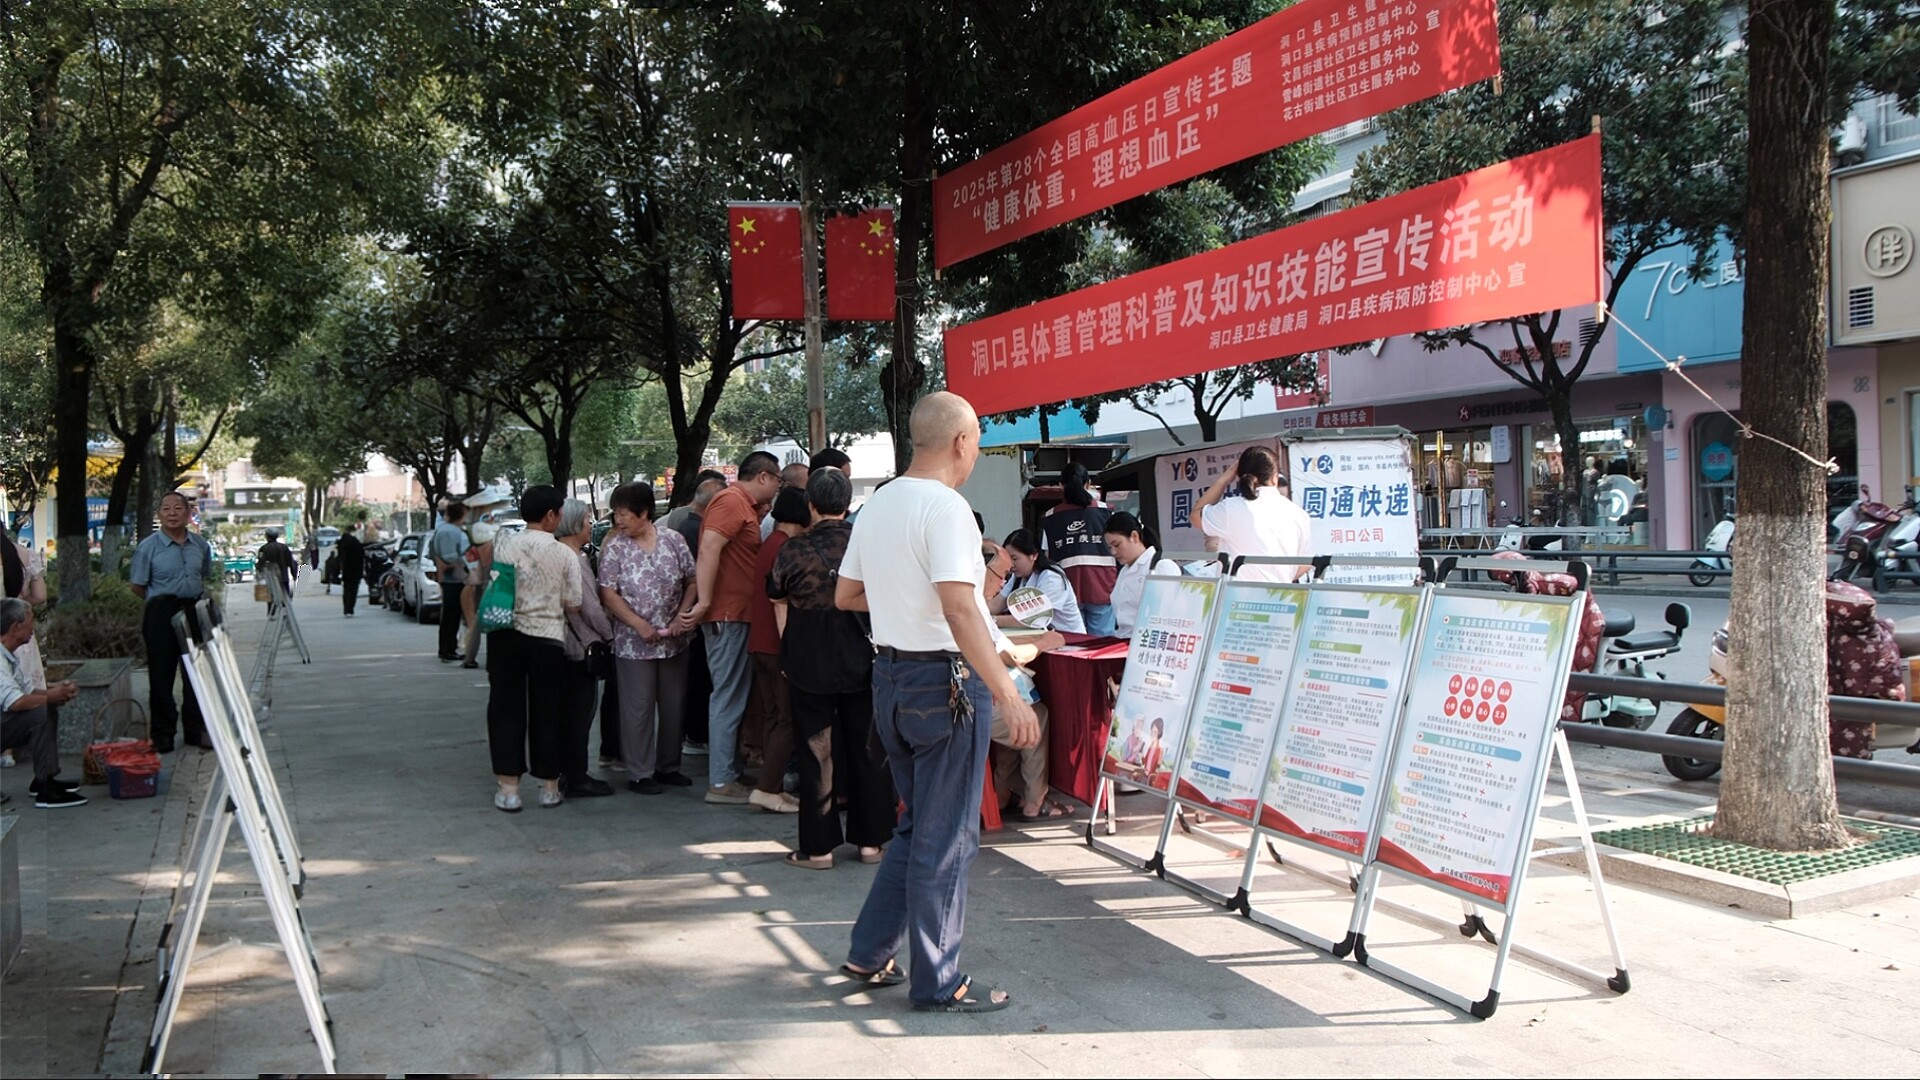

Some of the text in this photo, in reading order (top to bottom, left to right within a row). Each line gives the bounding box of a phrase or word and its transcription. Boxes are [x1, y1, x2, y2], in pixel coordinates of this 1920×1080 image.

[1280, 0, 1396, 49] 洞口县卫生健
[1281, 1, 1417, 68] 洞口县疾病预防控制中心
[1426, 10, 1441, 31] 宣
[1282, 20, 1418, 86] 文昌街道社区卫生服务中心
[1283, 61, 1421, 122] 花古街道社区卫生服务中心
[953, 52, 1253, 209] 2025年第28个全国高血压日宣传主题
[971, 185, 1534, 377] 洞口县体重管理科普及知识技能宣传活动
[1209, 261, 1526, 350] 洞口县卫生健康局 洞口县疾病预防控制中心 宣
[1303, 482, 1410, 519] 圆通快递
[1330, 527, 1384, 544] 洞口公司
